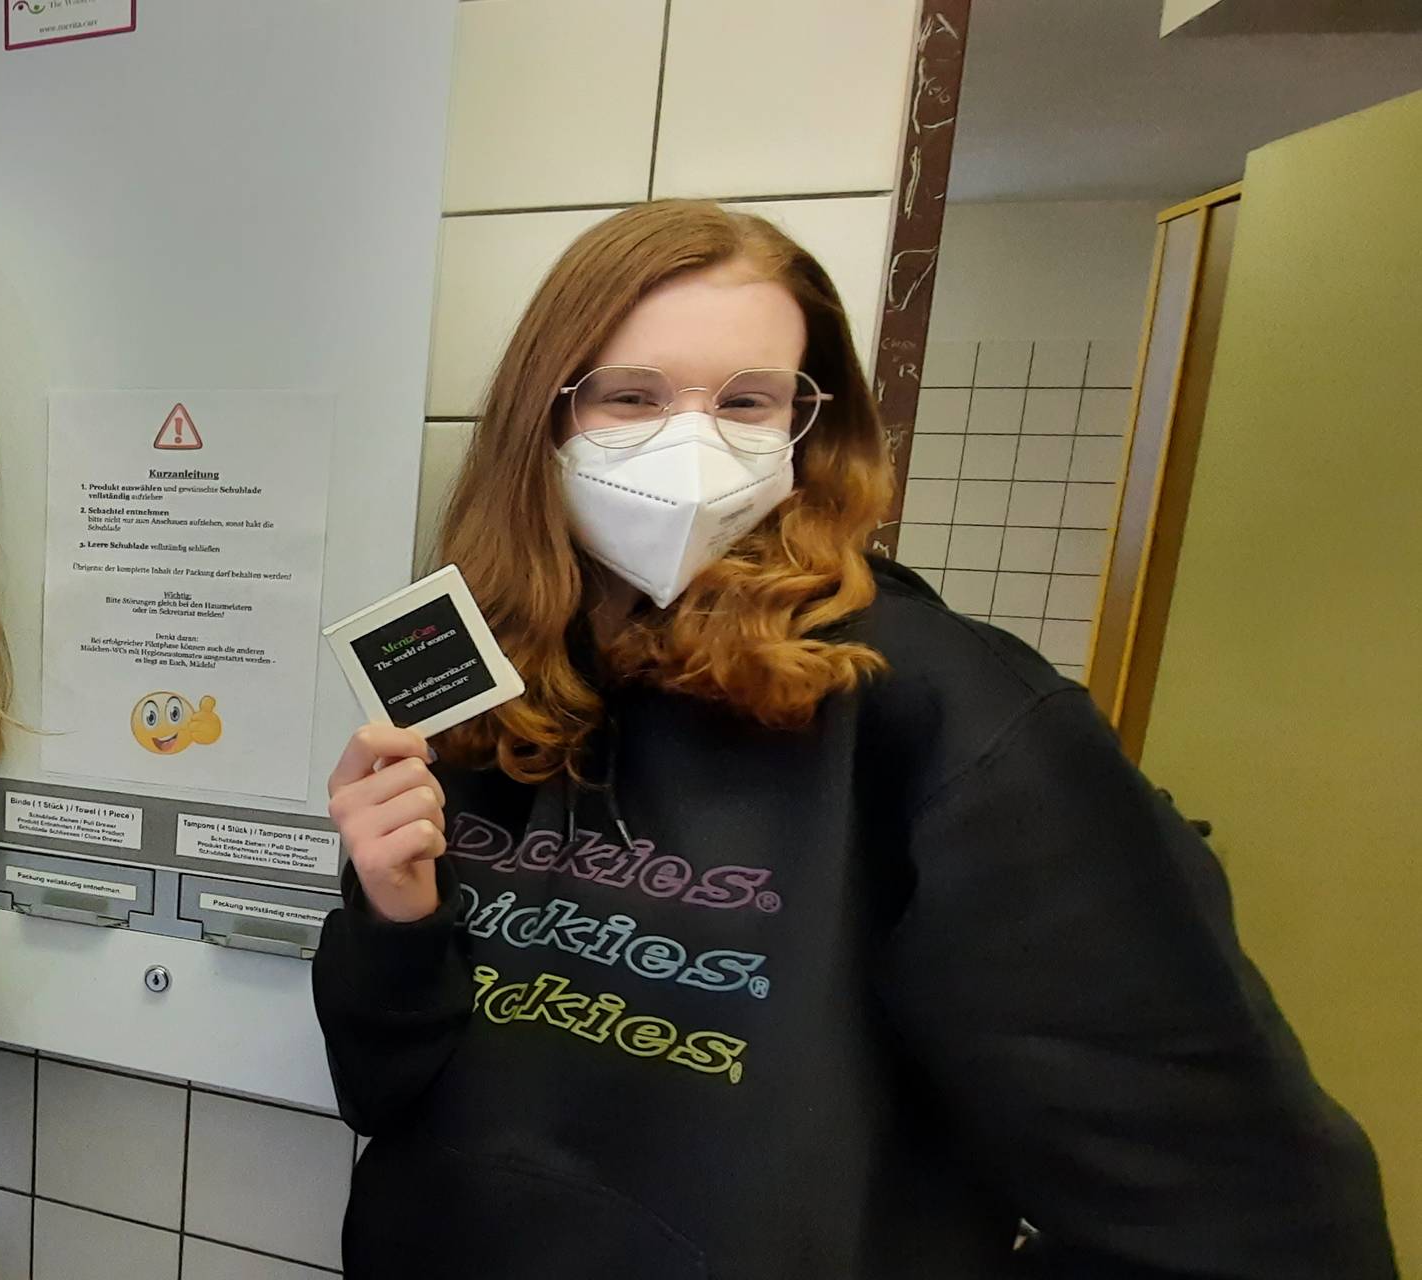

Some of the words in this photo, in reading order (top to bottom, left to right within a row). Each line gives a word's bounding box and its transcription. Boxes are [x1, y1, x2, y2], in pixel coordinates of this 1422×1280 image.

[149, 469, 219, 480] Kurzanleitung
[88, 492, 130, 500] vollständig
[121, 484, 162, 492] auswählen
[219, 486, 262, 494] Schublade
[88, 507, 124, 515] Schachtel
[126, 508, 169, 516] entnehmen
[110, 541, 149, 550] Schublade
[150, 543, 187, 552] vollständig
[374, 658, 393, 673] The
[393, 646, 417, 665] world
[416, 641, 427, 653] of
[426, 628, 457, 648] women
[387, 688, 412, 705] email:
[412, 656, 478, 695] info@merita.care
[405, 674, 470, 710] www.merita.care
[10, 797, 31, 806] Binde
[43, 801, 64, 810] Stück
[75, 805, 96, 815] Towel
[109, 810, 130, 819] Piece
[183, 819, 215, 831] Tampons
[227, 825, 248, 834] Stück
[259, 829, 292, 840] Tampons
[305, 834, 330, 845] Pieces
[212, 899, 244, 911] Packung
[245, 904, 285, 918] vollständig
[285, 911, 325, 923] entnehme
